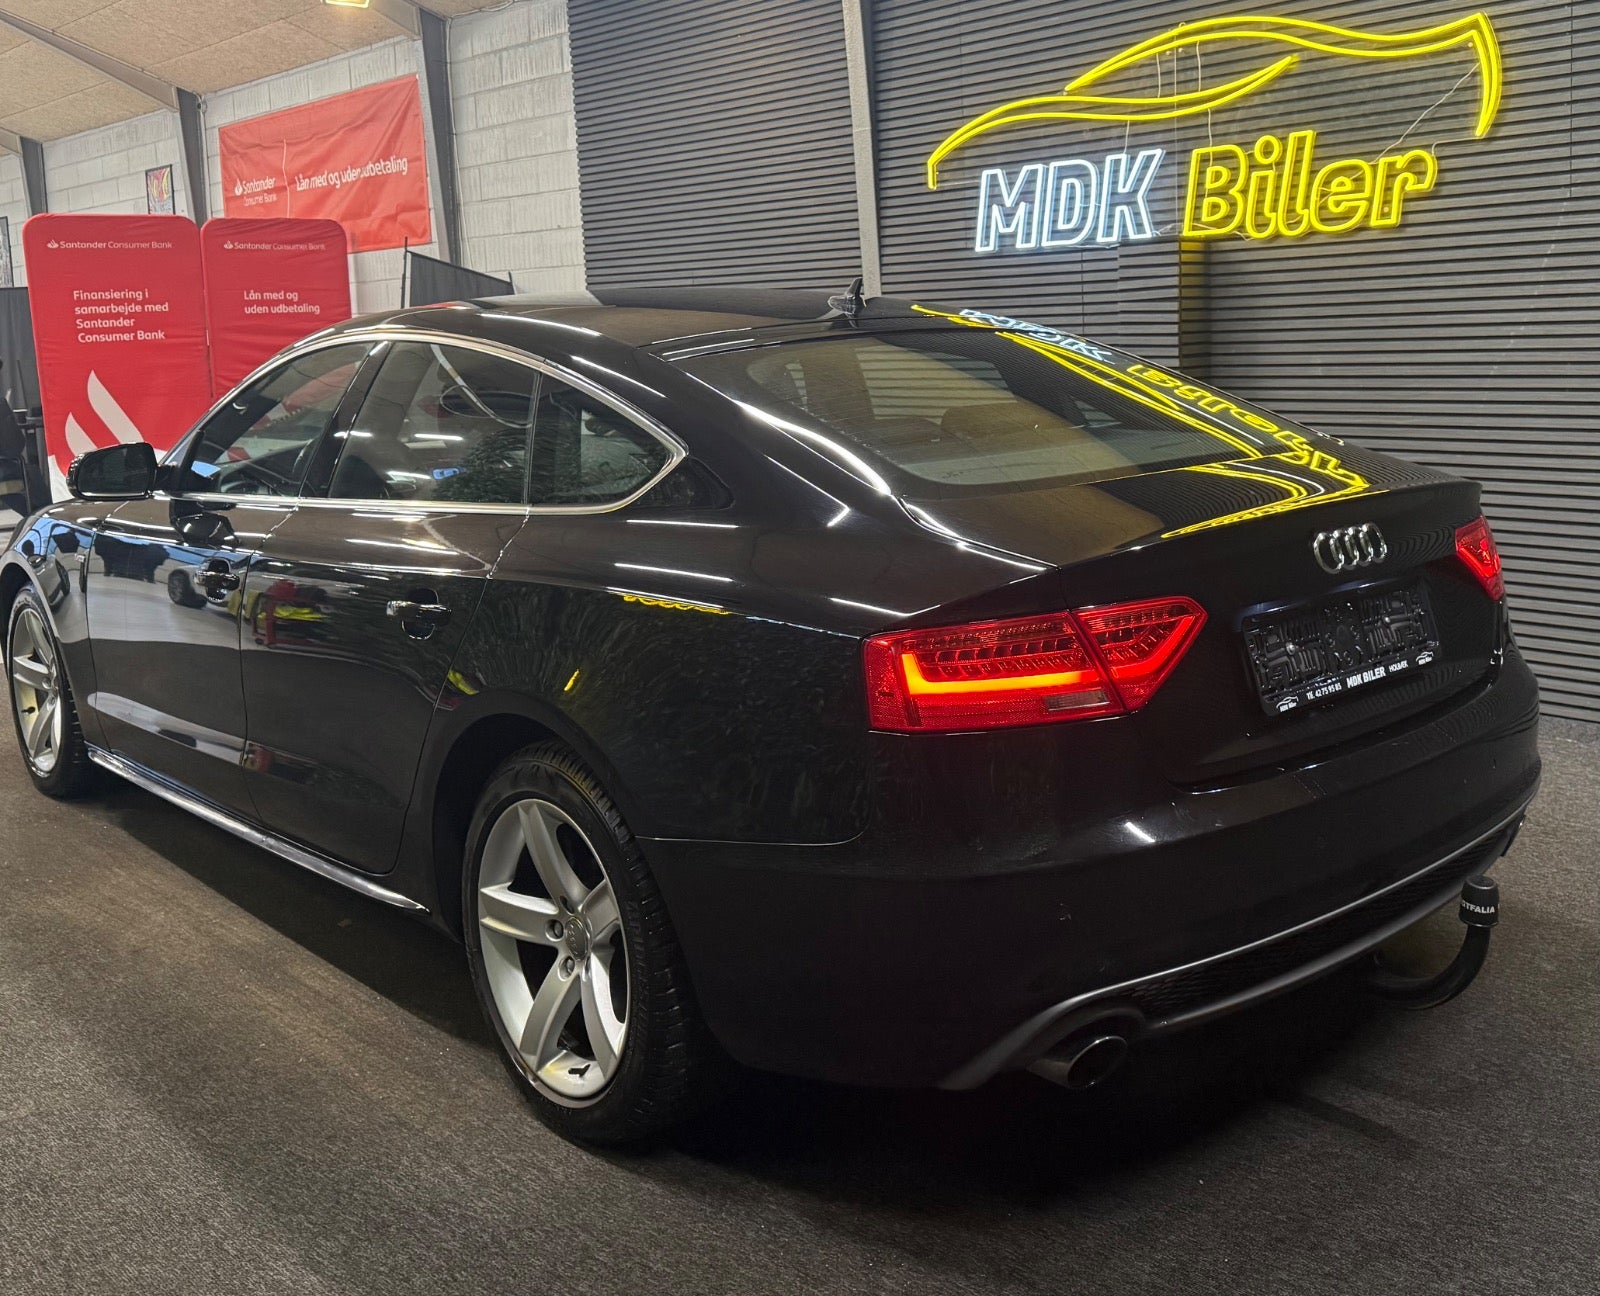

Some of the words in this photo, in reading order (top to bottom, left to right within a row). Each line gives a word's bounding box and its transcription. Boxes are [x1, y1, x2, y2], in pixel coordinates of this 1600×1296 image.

[242, 176, 276, 195] Santander
[295, 173, 311, 191] Lån
[310, 170, 327, 188] med
[328, 170, 340, 189] og
[974, 147, 1163, 253] MDK
[1181, 129, 1437, 239] Biler
[60, 241, 107, 249] Santander
[108, 241, 150, 249] Consumer
[151, 241, 173, 249] Bank
[234, 241, 272, 250] Santander
[73, 289, 143, 301] Finansiering
[145, 288, 149, 299] i
[243, 289, 262, 301] Lån
[263, 290, 285, 300] med
[286, 292, 299, 302] og
[74, 303, 142, 315] samarbejde
[144, 302, 169, 312] med
[244, 304, 269, 314] uden
[270, 303, 321, 315] udbetaling
[76, 317, 135, 329] Santander
[78, 332, 135, 343] Consumer
[137, 330, 165, 341] Bank
[1346, 676, 1363, 689] MDK
[1363, 667, 1387, 683] BILER
